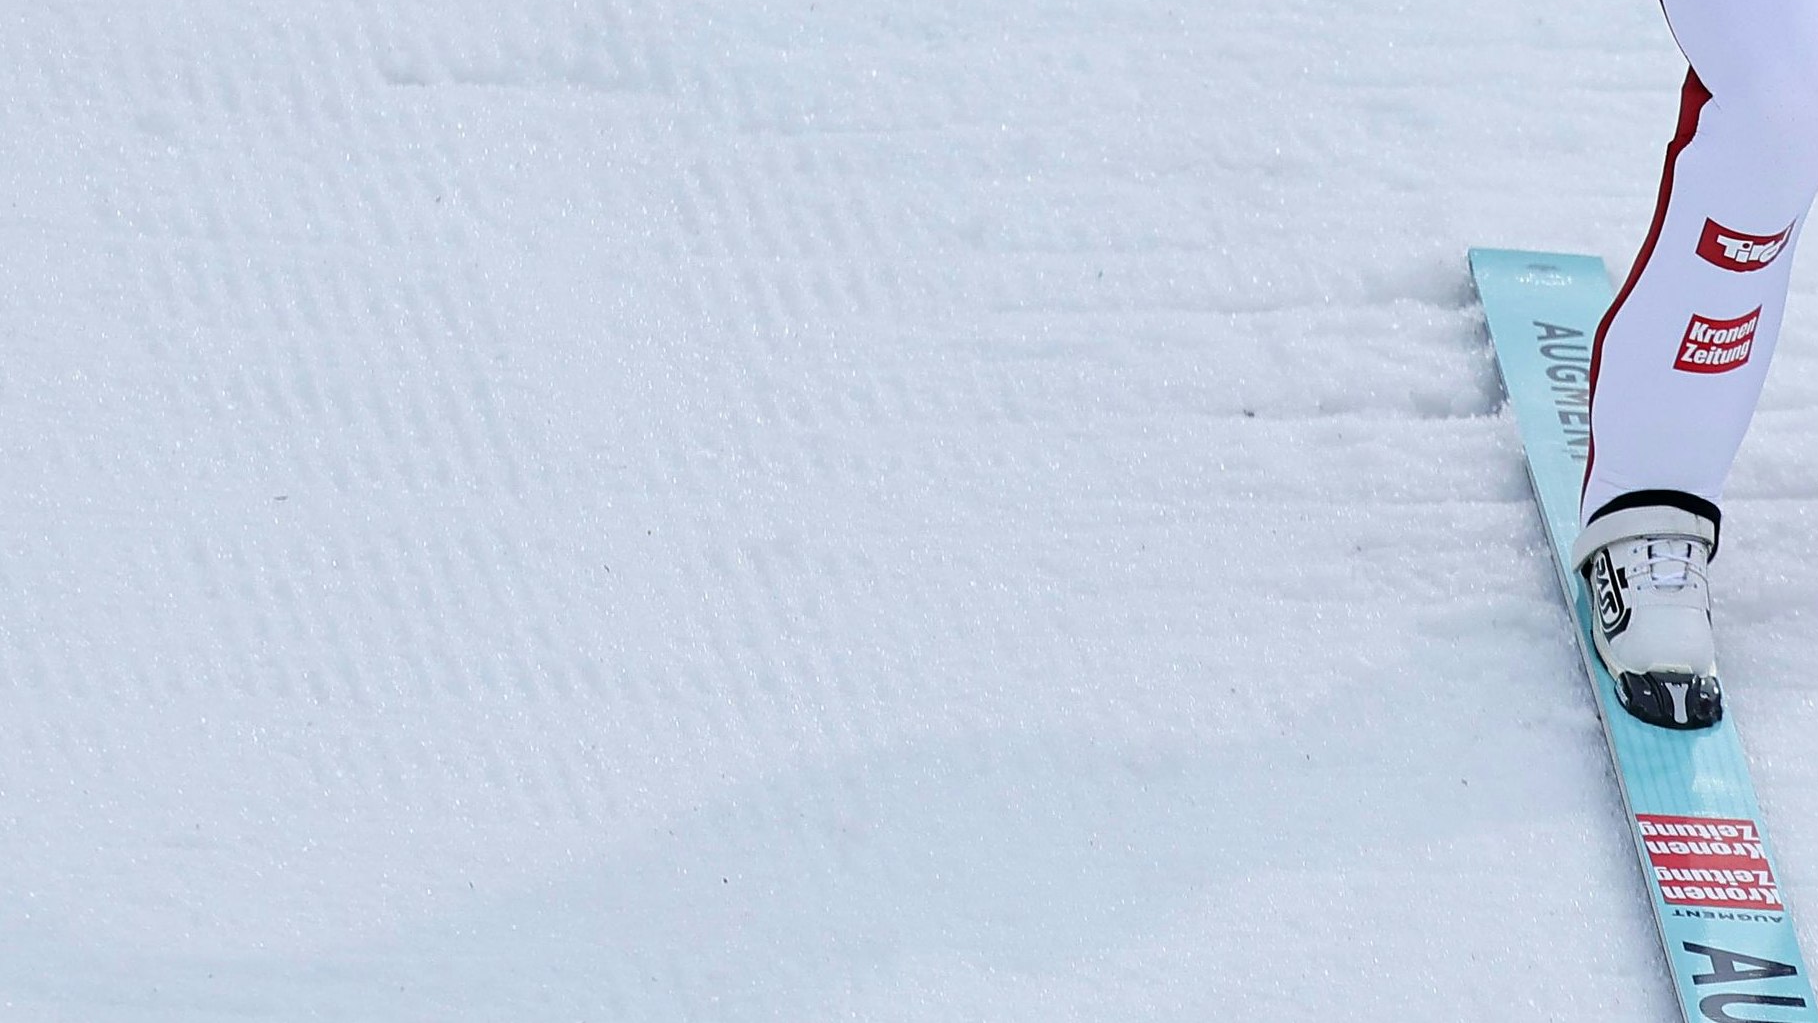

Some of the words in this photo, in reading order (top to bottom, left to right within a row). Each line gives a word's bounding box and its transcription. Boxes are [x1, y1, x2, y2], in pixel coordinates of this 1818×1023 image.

[1689, 316, 1757, 344] Kronen
[1681, 339, 1751, 365] Zeitung
[1638, 821, 1760, 841] Zeitung
[1646, 841, 1768, 860] Kronen
[1654, 866, 1776, 886] Zeitung
[1661, 885, 1782, 905] Kronen
[1672, 909, 1783, 924] AUGMENT
